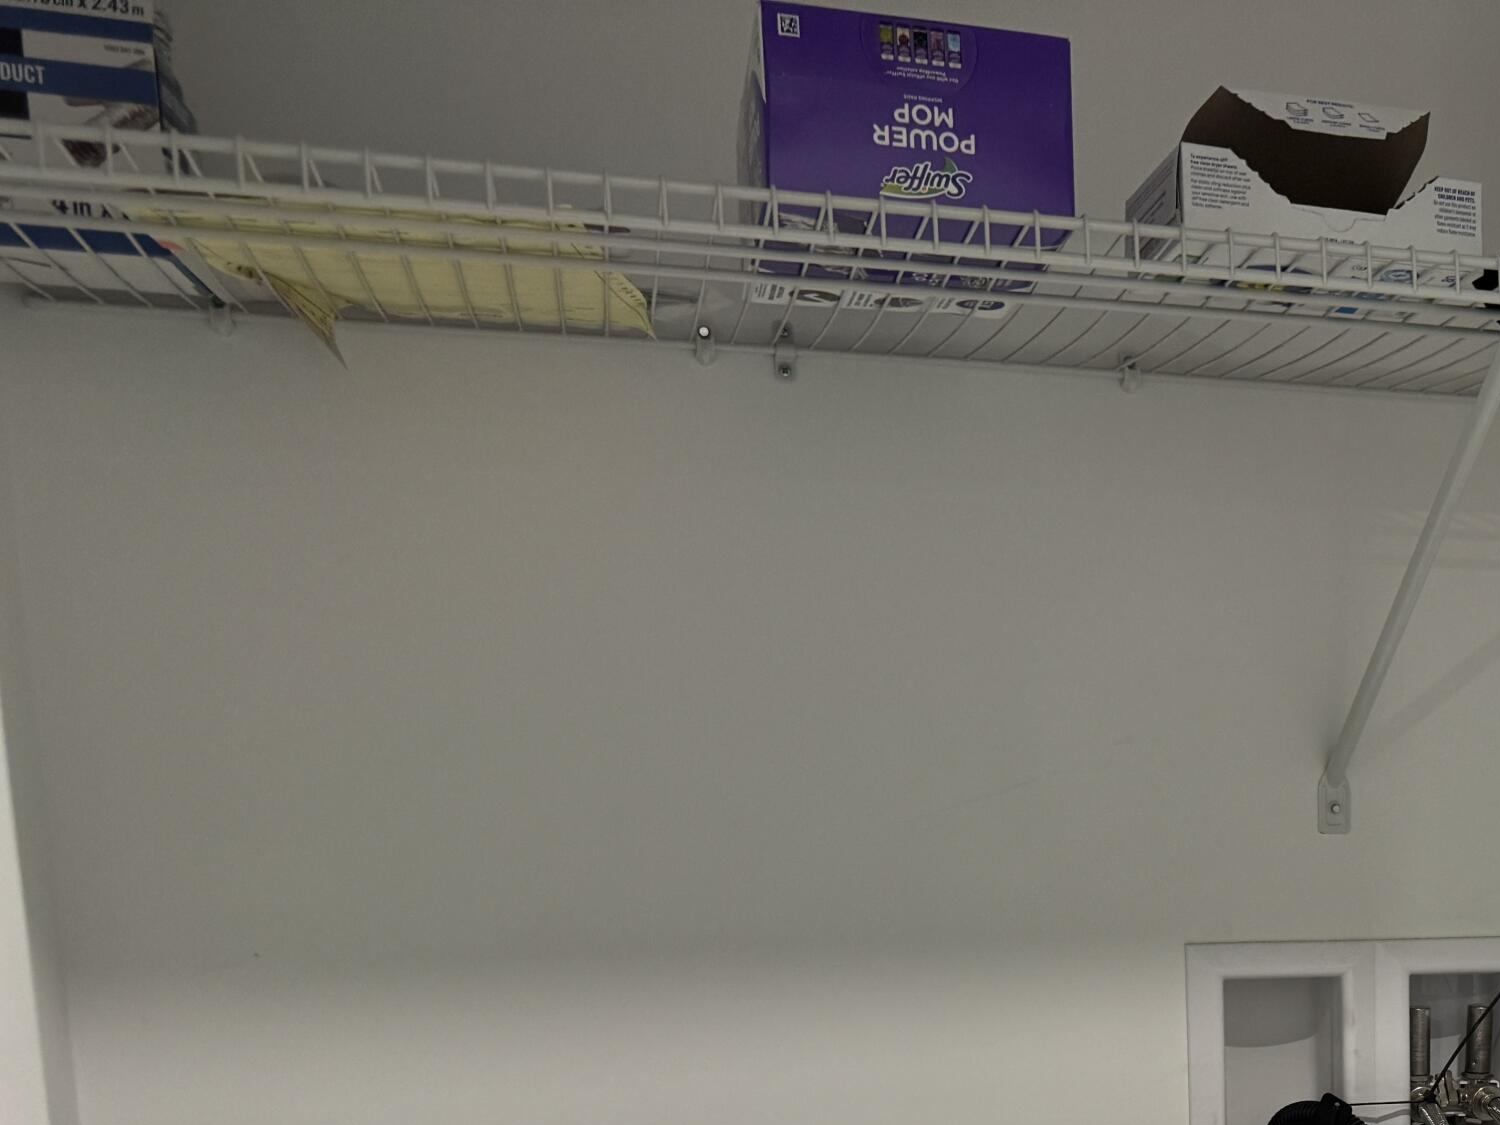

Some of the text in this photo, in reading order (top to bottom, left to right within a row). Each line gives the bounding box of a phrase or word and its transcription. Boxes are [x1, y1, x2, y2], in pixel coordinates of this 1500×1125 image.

[92, 0, 129, 16] 2.43
[131, 7, 145, 16] m
[0, 62, 46, 85] DUCT
[893, 102, 954, 129] MOP
[872, 123, 976, 155] POWER
[882, 161, 973, 199] Swiffer
